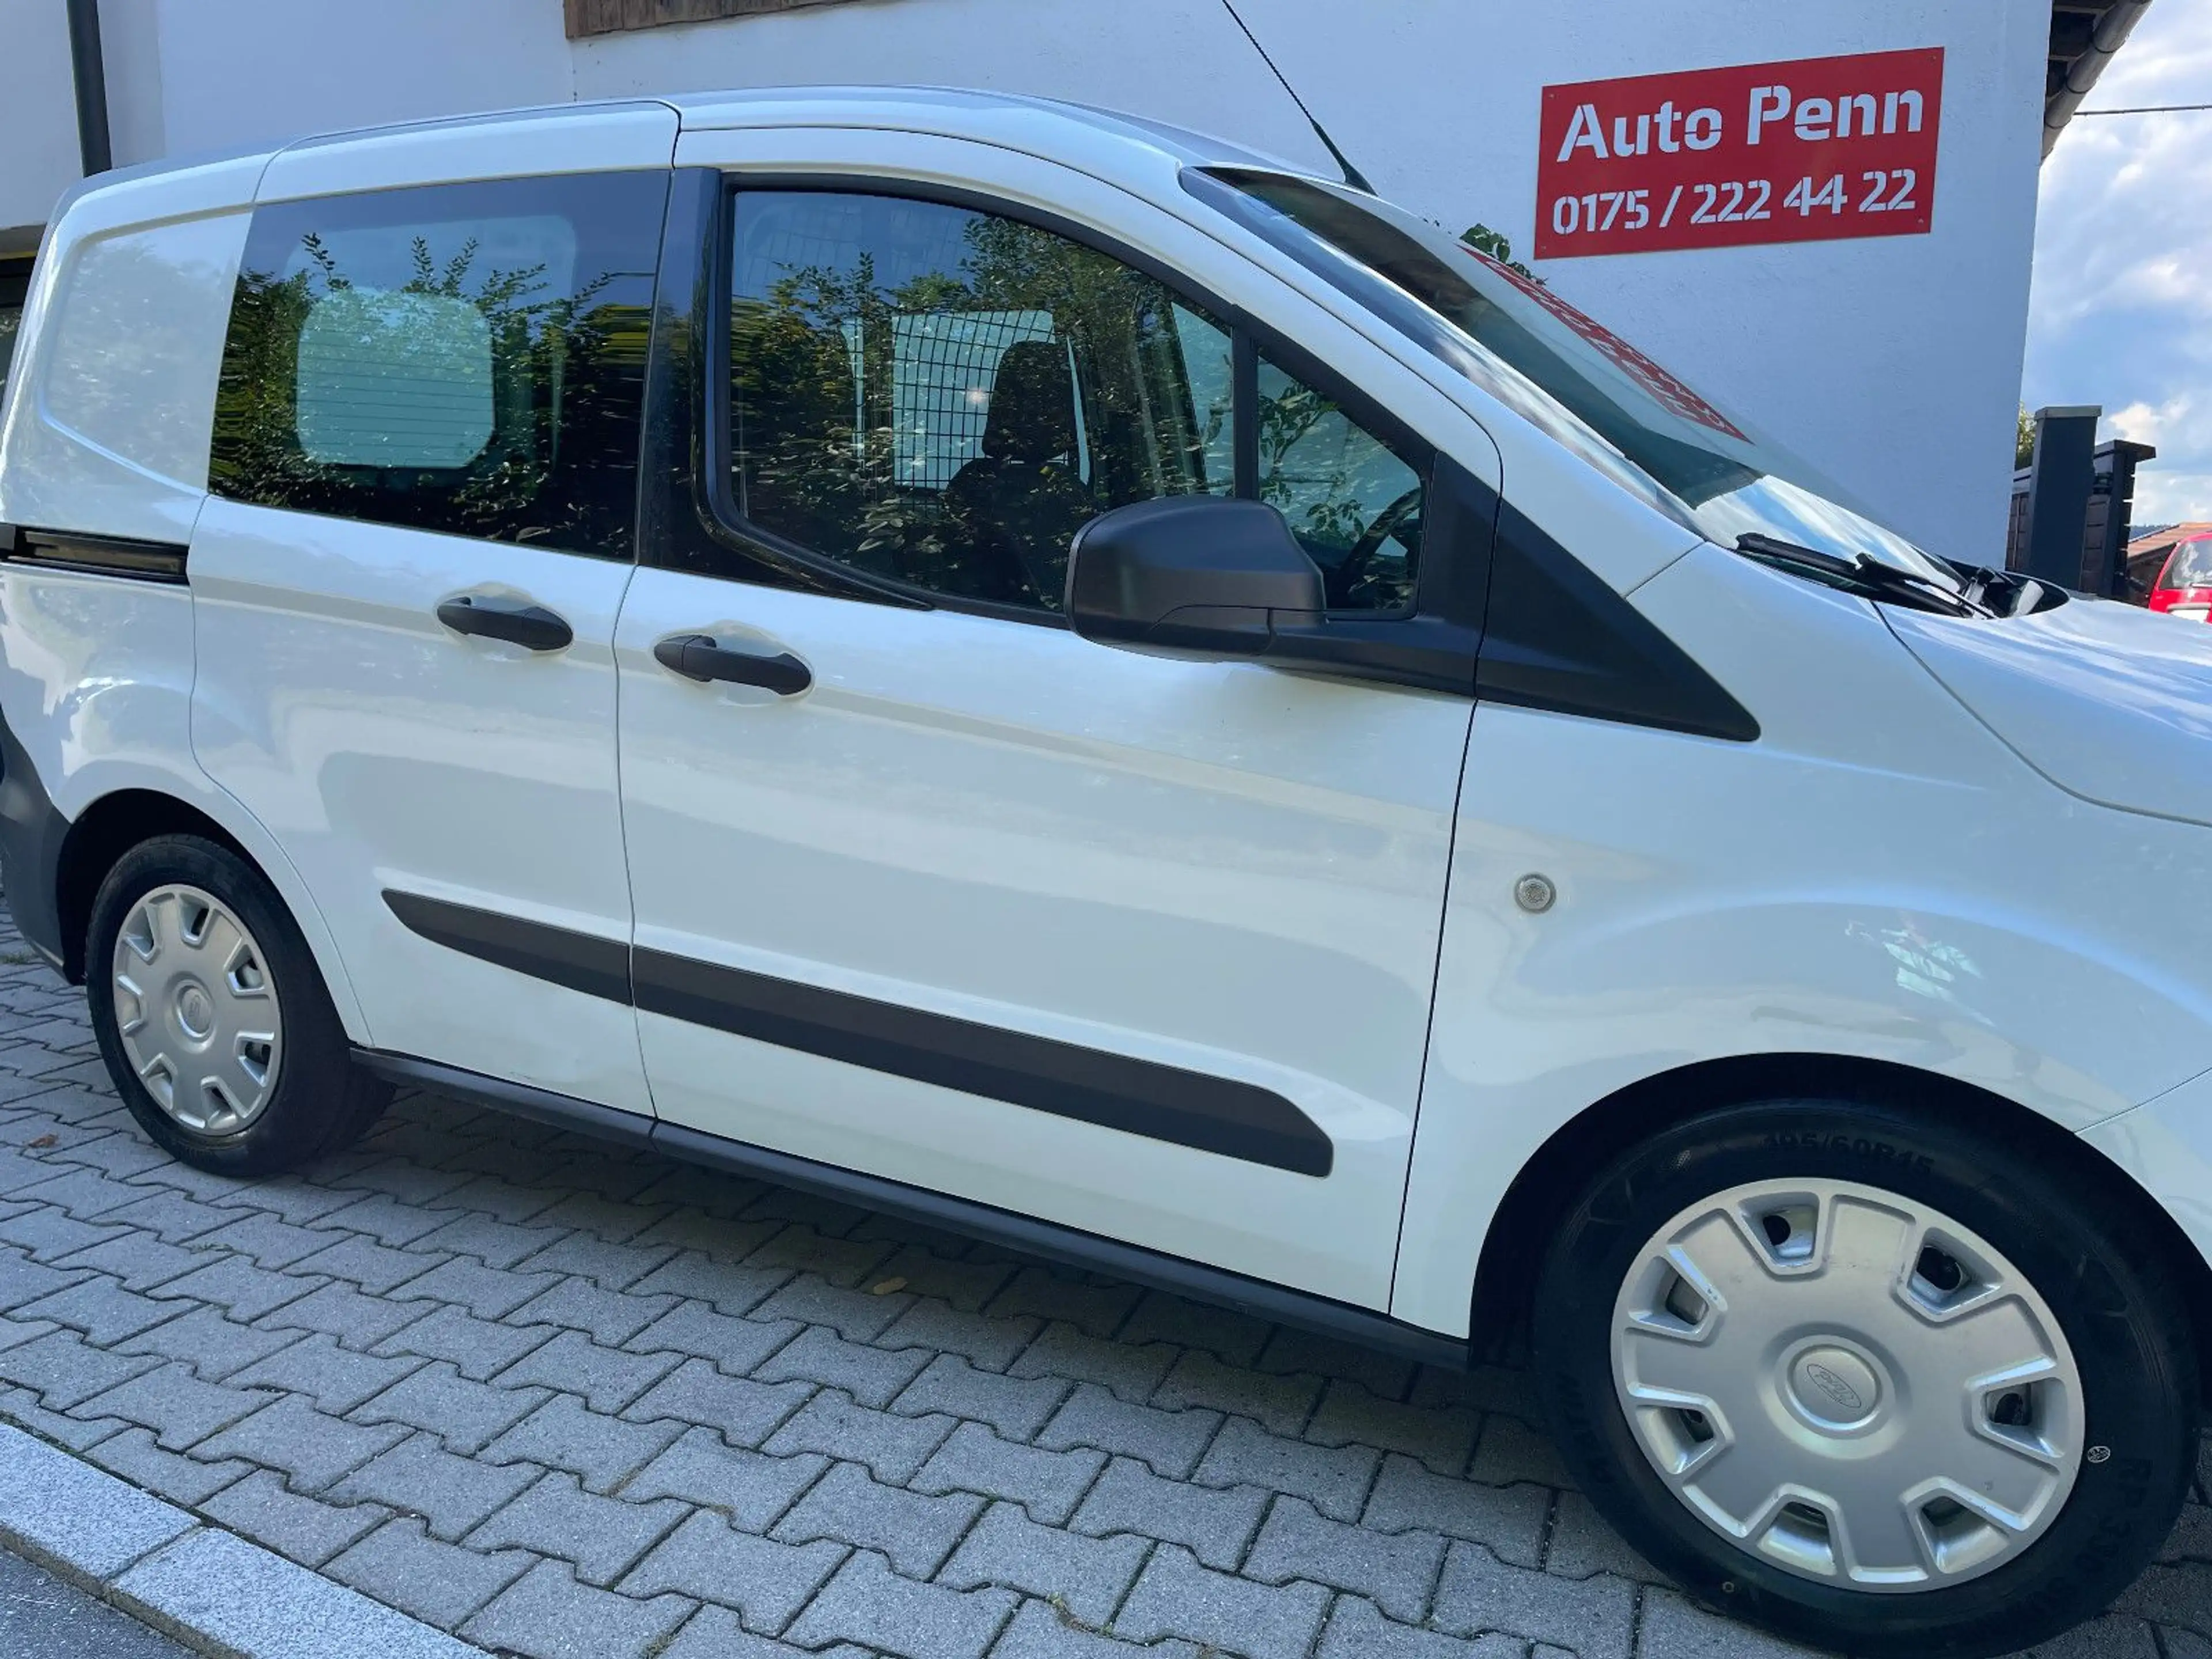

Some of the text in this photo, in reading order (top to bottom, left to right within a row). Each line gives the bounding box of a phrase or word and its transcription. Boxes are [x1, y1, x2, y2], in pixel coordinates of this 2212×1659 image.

[1557, 85, 1923, 162] Auto Penn
[1553, 169, 1915, 234] 0175 / 222 44 22
